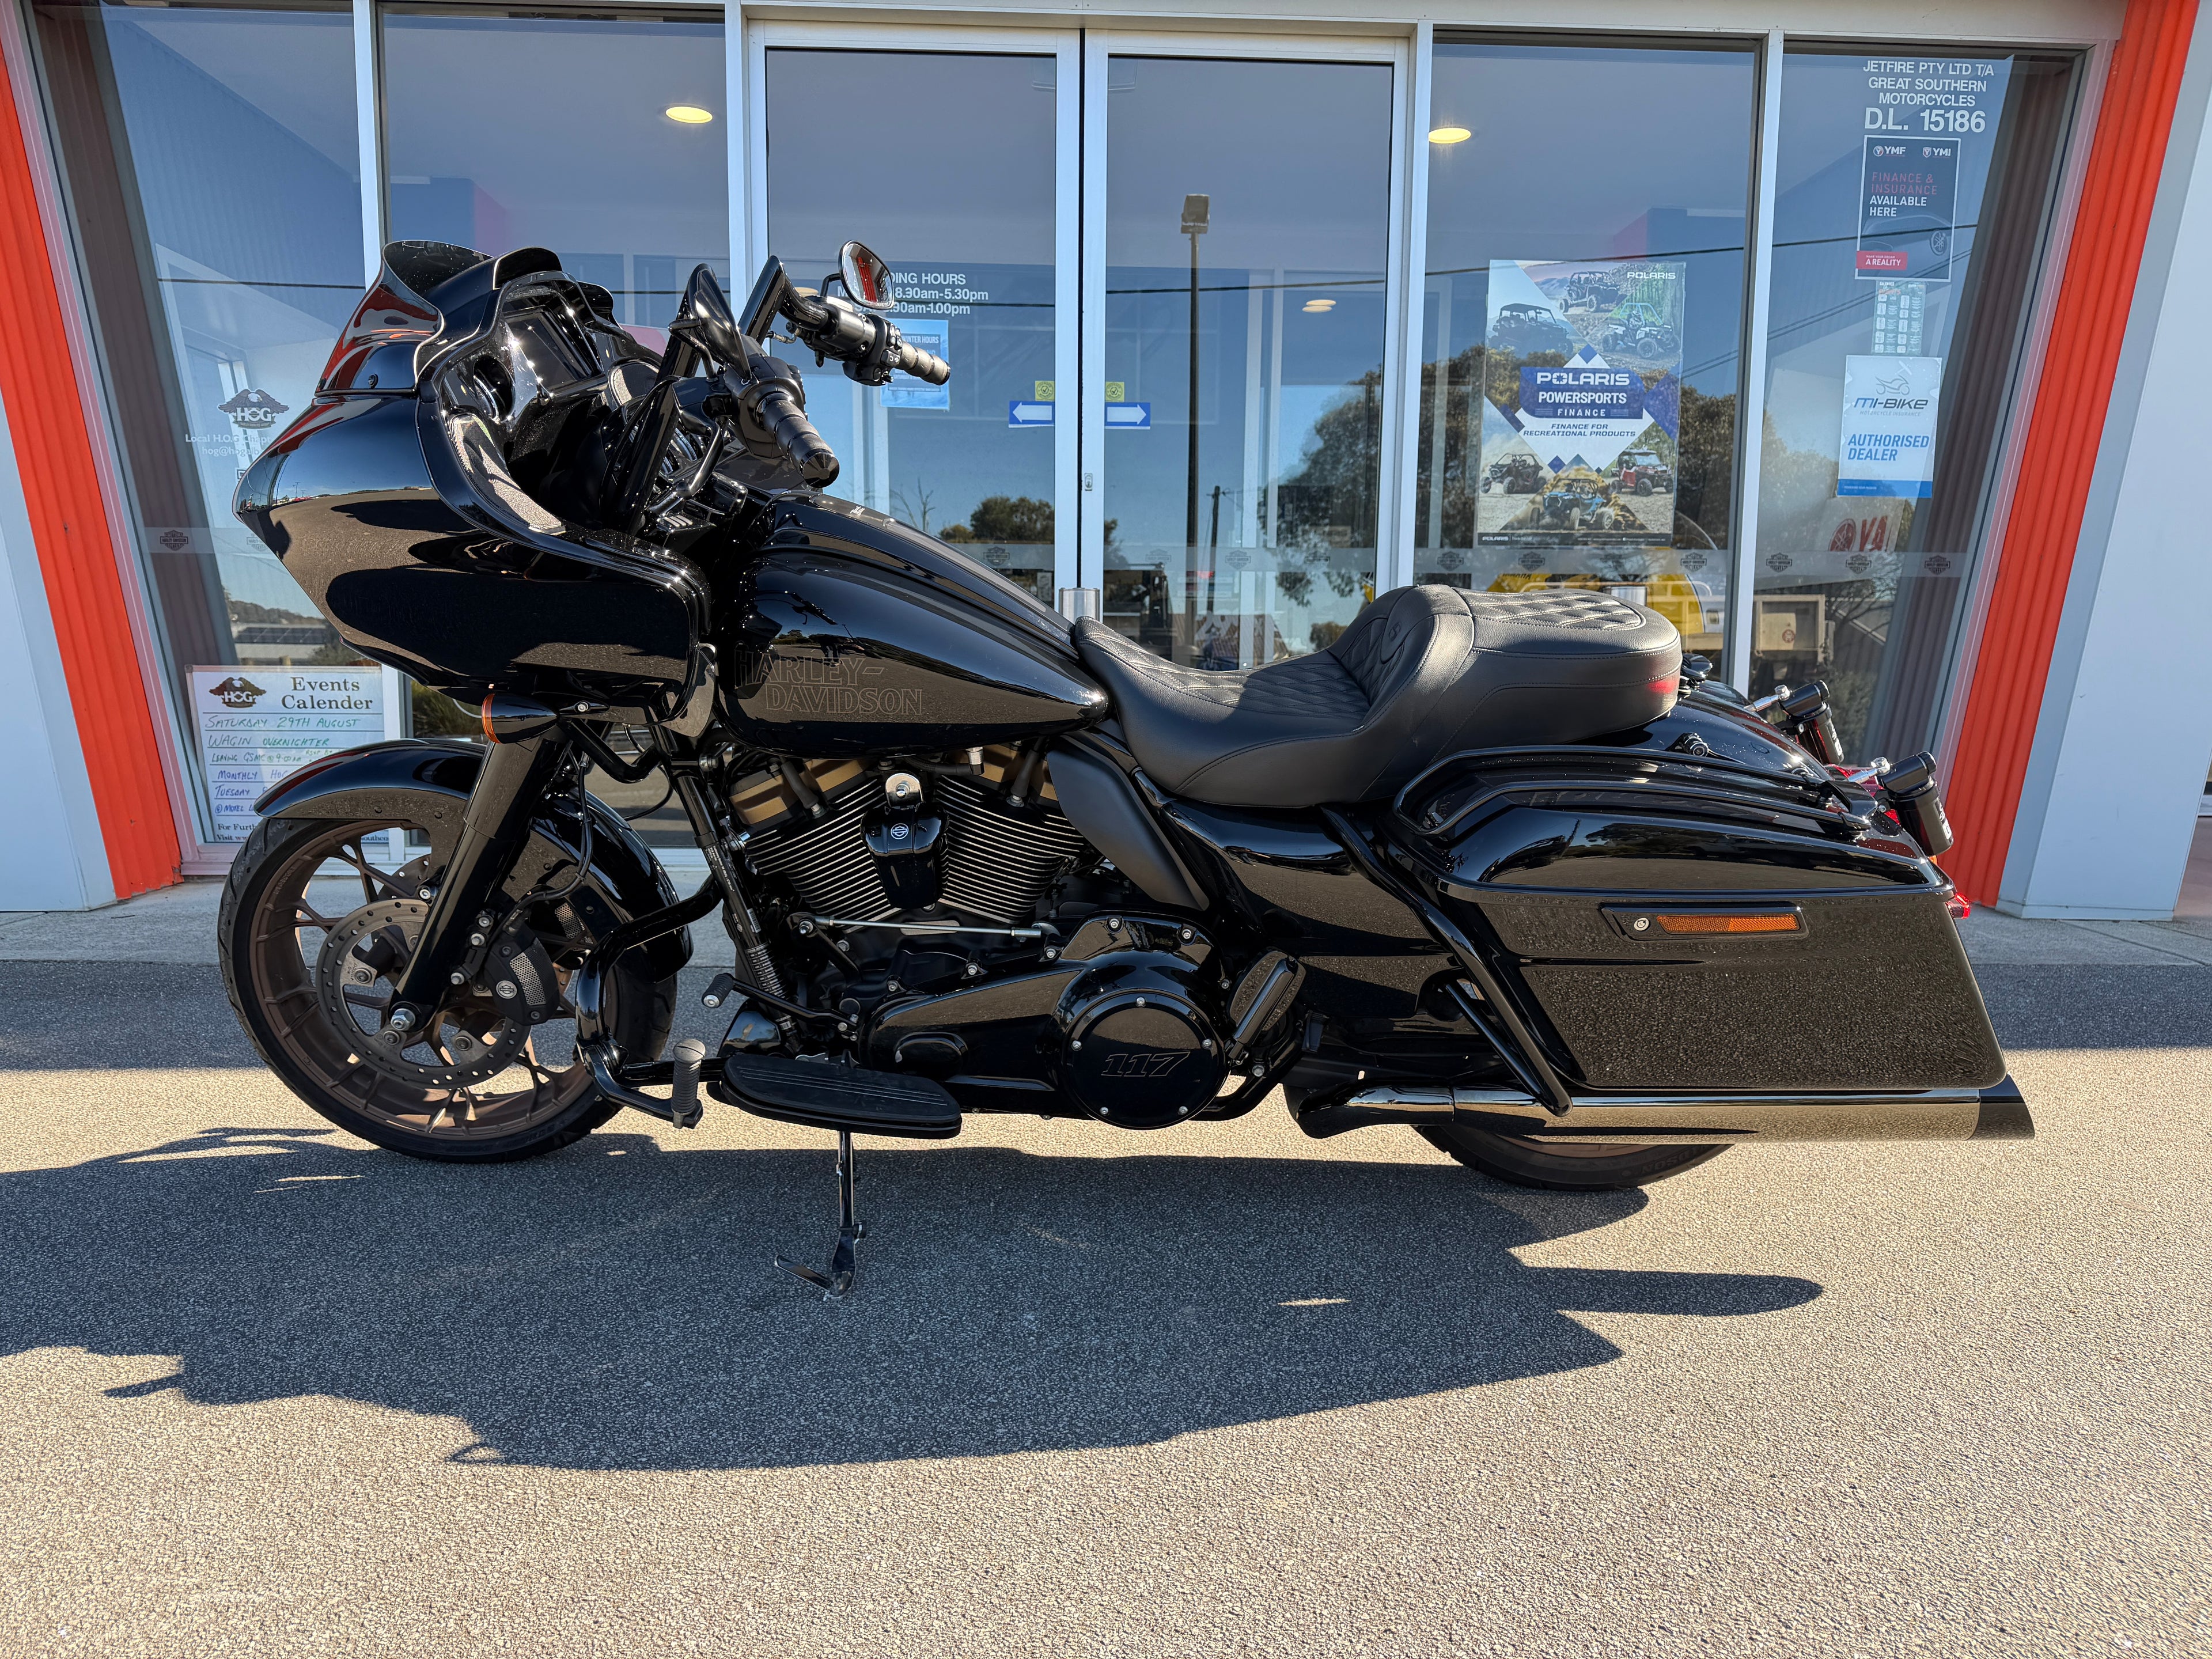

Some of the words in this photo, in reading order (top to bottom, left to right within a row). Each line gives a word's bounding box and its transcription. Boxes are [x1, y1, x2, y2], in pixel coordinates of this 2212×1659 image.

[1863, 60, 1915, 73] JETFIRE
[1919, 62, 1945, 74] PTY
[1949, 63, 1972, 75] LTD
[1975, 64, 1995, 77] T/A
[1868, 77, 1911, 89] GREAT
[1915, 78, 1987, 92] SOUTHERN
[1878, 92, 1976, 107] MOTORCYCLES
[1864, 107, 1908, 130] D.L.
[1920, 109, 1986, 133] 15186
[1884, 146, 1906, 154] YMF
[1933, 147, 1951, 156] YMI
[1872, 172, 1922, 183] FINANCE
[1926, 173, 1934, 184] &
[1871, 184, 1938, 195] INSURANCE
[1869, 195, 1927, 206] AVAILABLE
[1869, 207, 1897, 217] HERE
[922, 273, 966, 285] HOURS
[1626, 271, 1676, 279] POLARIS
[1536, 372, 1630, 385] POLARIS
[1538, 391, 1627, 404] POWERSPORTS
[1557, 408, 1606, 417] FINANCE
[185, 434, 210, 442] Local
[1847, 434, 1930, 448] AUTHORISED
[1847, 448, 1898, 461] DEALER
[290, 676, 360, 691] Events
[224, 691, 253, 703] HOG
[281, 694, 373, 710] Calender
[764, 684, 922, 715] DAVIDSON
[205, 715, 267, 728] SATURDAY
[277, 717, 310, 728] 29TH
[316, 718, 361, 728] AUGUST
[208, 734, 253, 747] WAGIN
[263, 737, 329, 747] OVERNIGHTER
[211, 752, 237, 762] LEAVING
[218, 770, 257, 780] MONTHLY
[215, 785, 250, 798] TUESDAY
[224, 804, 244, 812] MOTEL
[1100, 1051, 1191, 1077] 117
